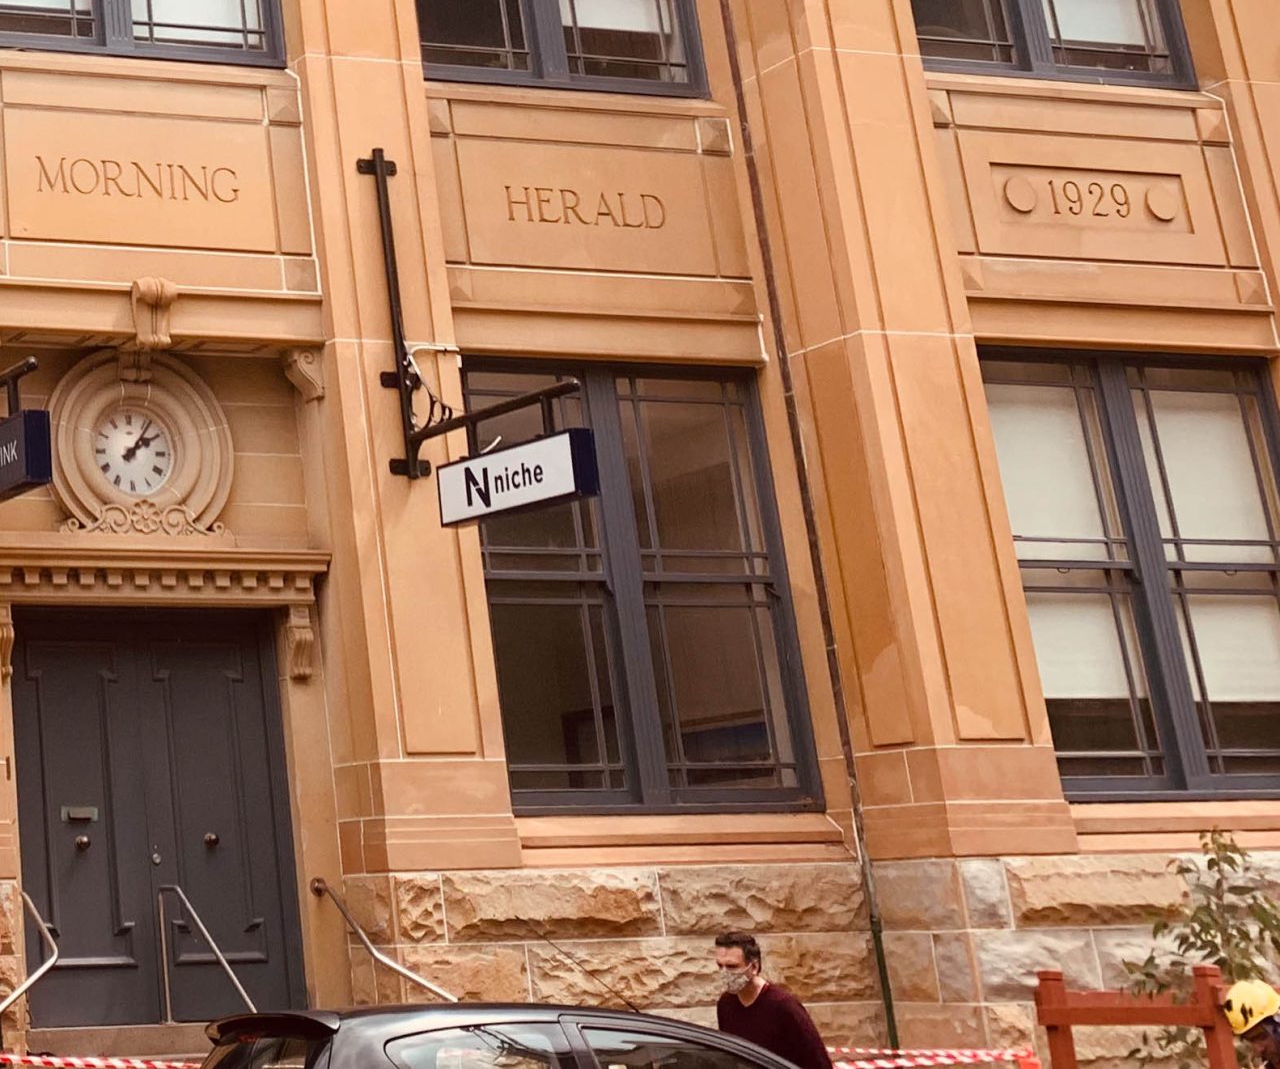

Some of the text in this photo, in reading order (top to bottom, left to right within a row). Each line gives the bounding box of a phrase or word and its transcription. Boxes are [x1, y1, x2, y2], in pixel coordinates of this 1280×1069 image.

[34, 155, 241, 203] MORNING
[503, 185, 667, 230] HERALD
[1047, 179, 1131, 219] 1929
[494, 462, 544, 494] niche
